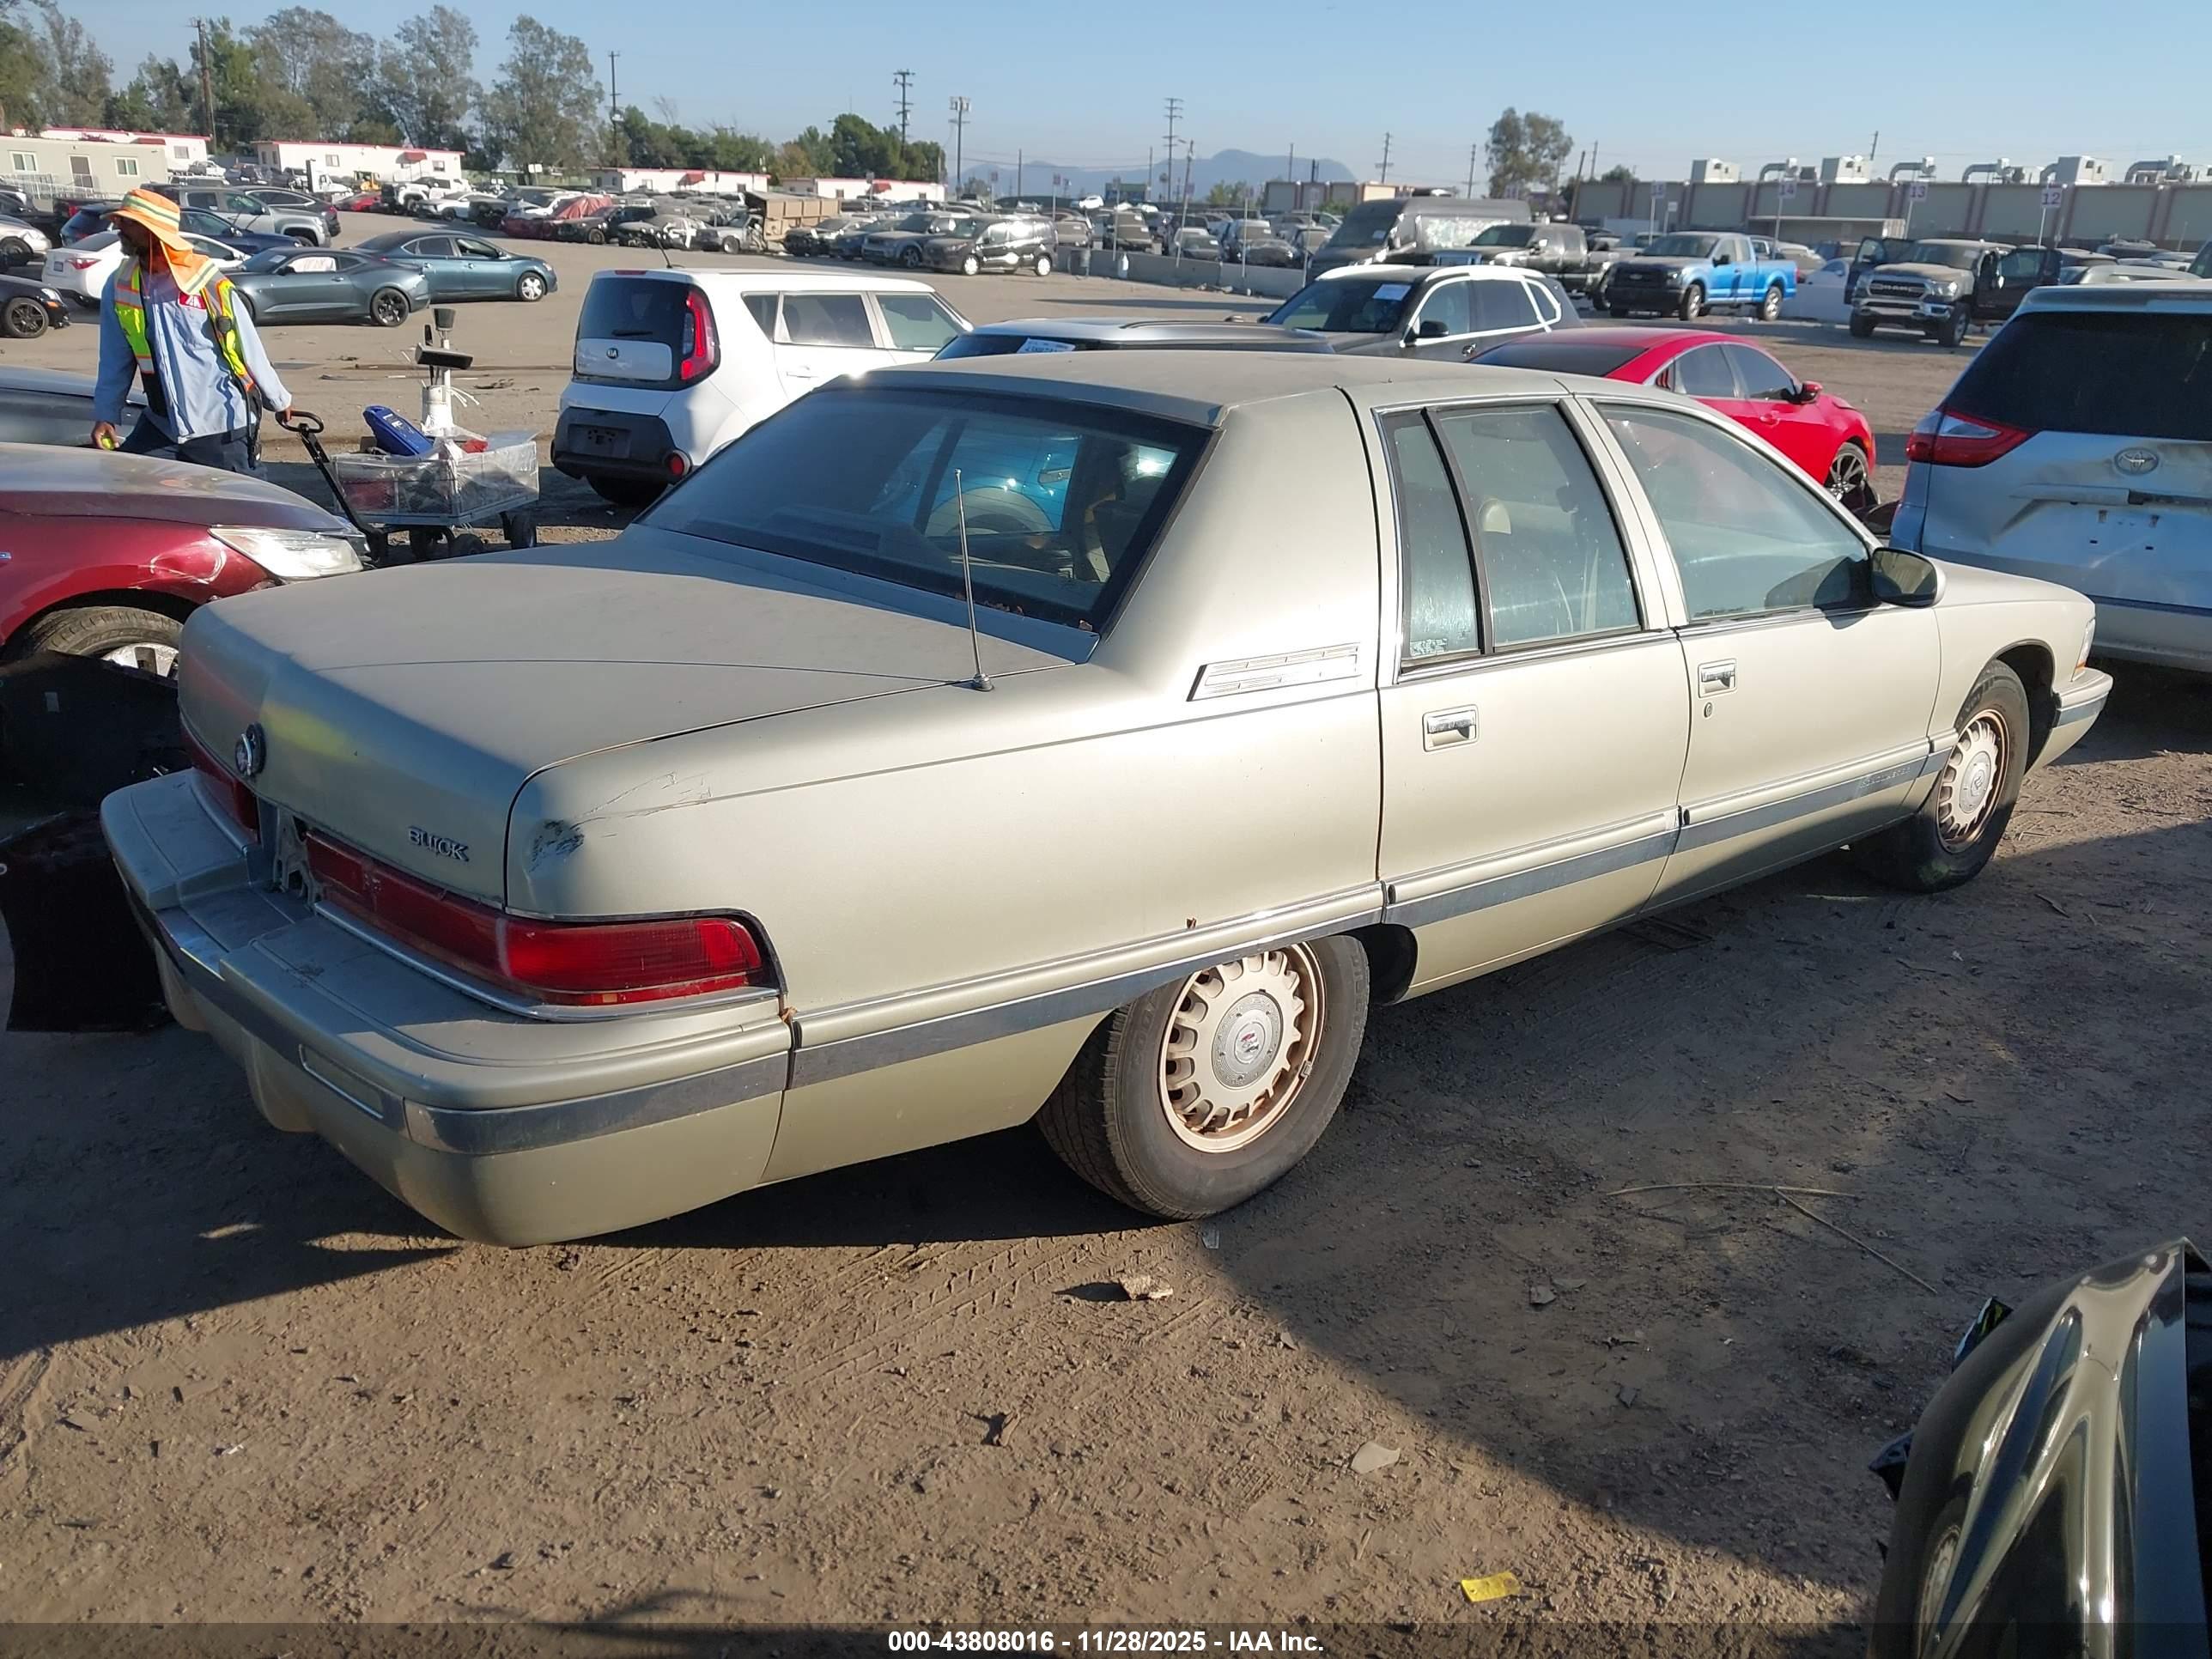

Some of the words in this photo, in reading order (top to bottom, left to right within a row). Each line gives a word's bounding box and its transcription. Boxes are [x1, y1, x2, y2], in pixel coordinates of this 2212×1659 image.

[1911, 185, 1925, 198] 13
[2042, 193, 2060, 204] 12
[408, 826, 469, 861] BUICK
